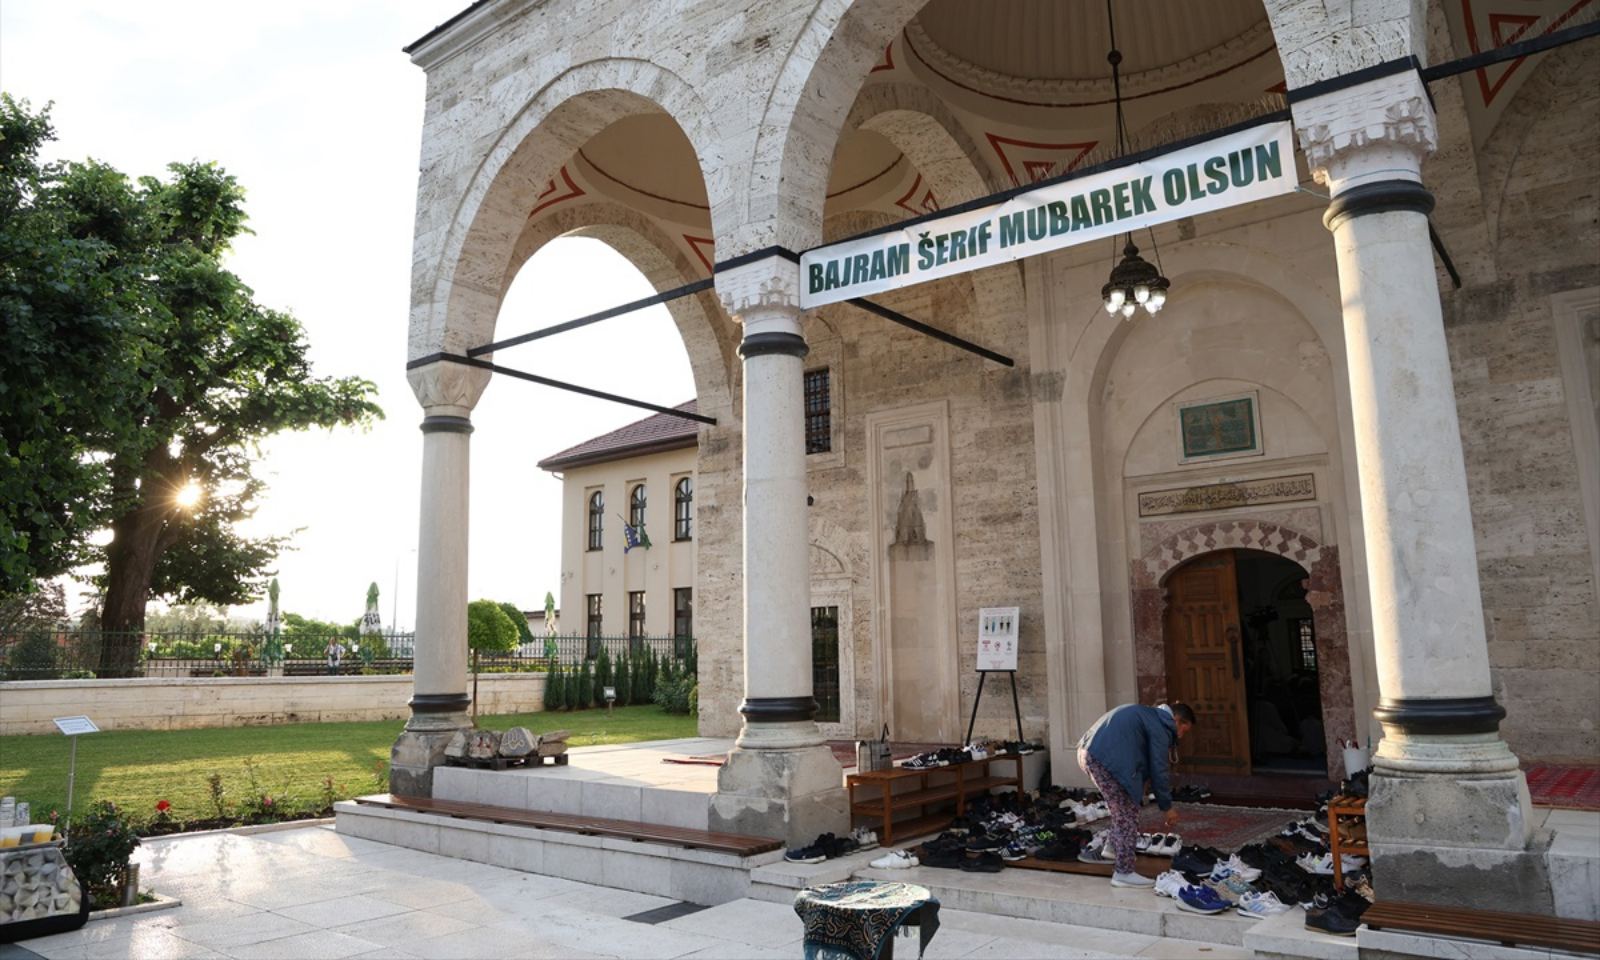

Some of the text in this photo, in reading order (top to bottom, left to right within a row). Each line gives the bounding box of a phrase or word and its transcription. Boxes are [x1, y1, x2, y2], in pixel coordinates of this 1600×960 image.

[809, 140, 1282, 294] BAJRAM ŠERIF MUBAREK OLSUN
